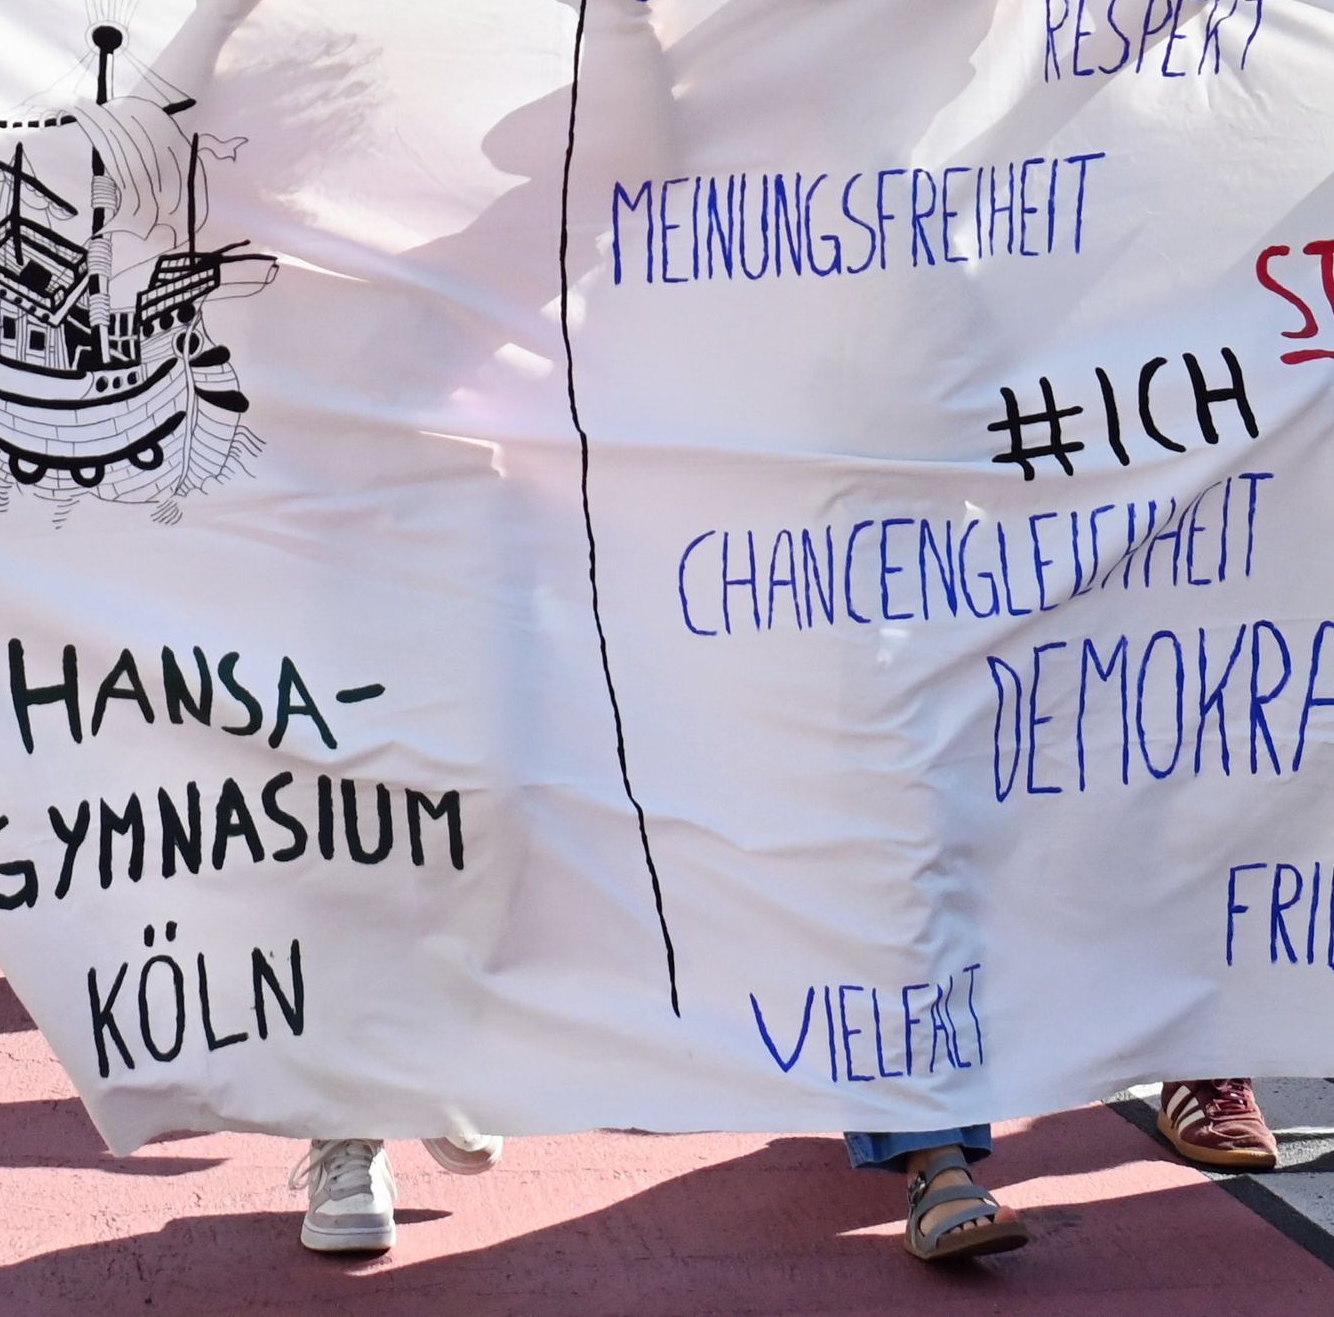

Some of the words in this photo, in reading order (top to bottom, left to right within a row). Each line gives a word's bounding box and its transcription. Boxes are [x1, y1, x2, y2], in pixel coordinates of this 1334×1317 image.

[612, 152, 1105, 284] MEINUNGSFREIHEIT
[987, 347, 1259, 480] #ICH
[8, 638, 386, 754] HANSA-
[87, 921, 305, 1078] KÖLN
[750, 964, 985, 1082] VIELFALT
